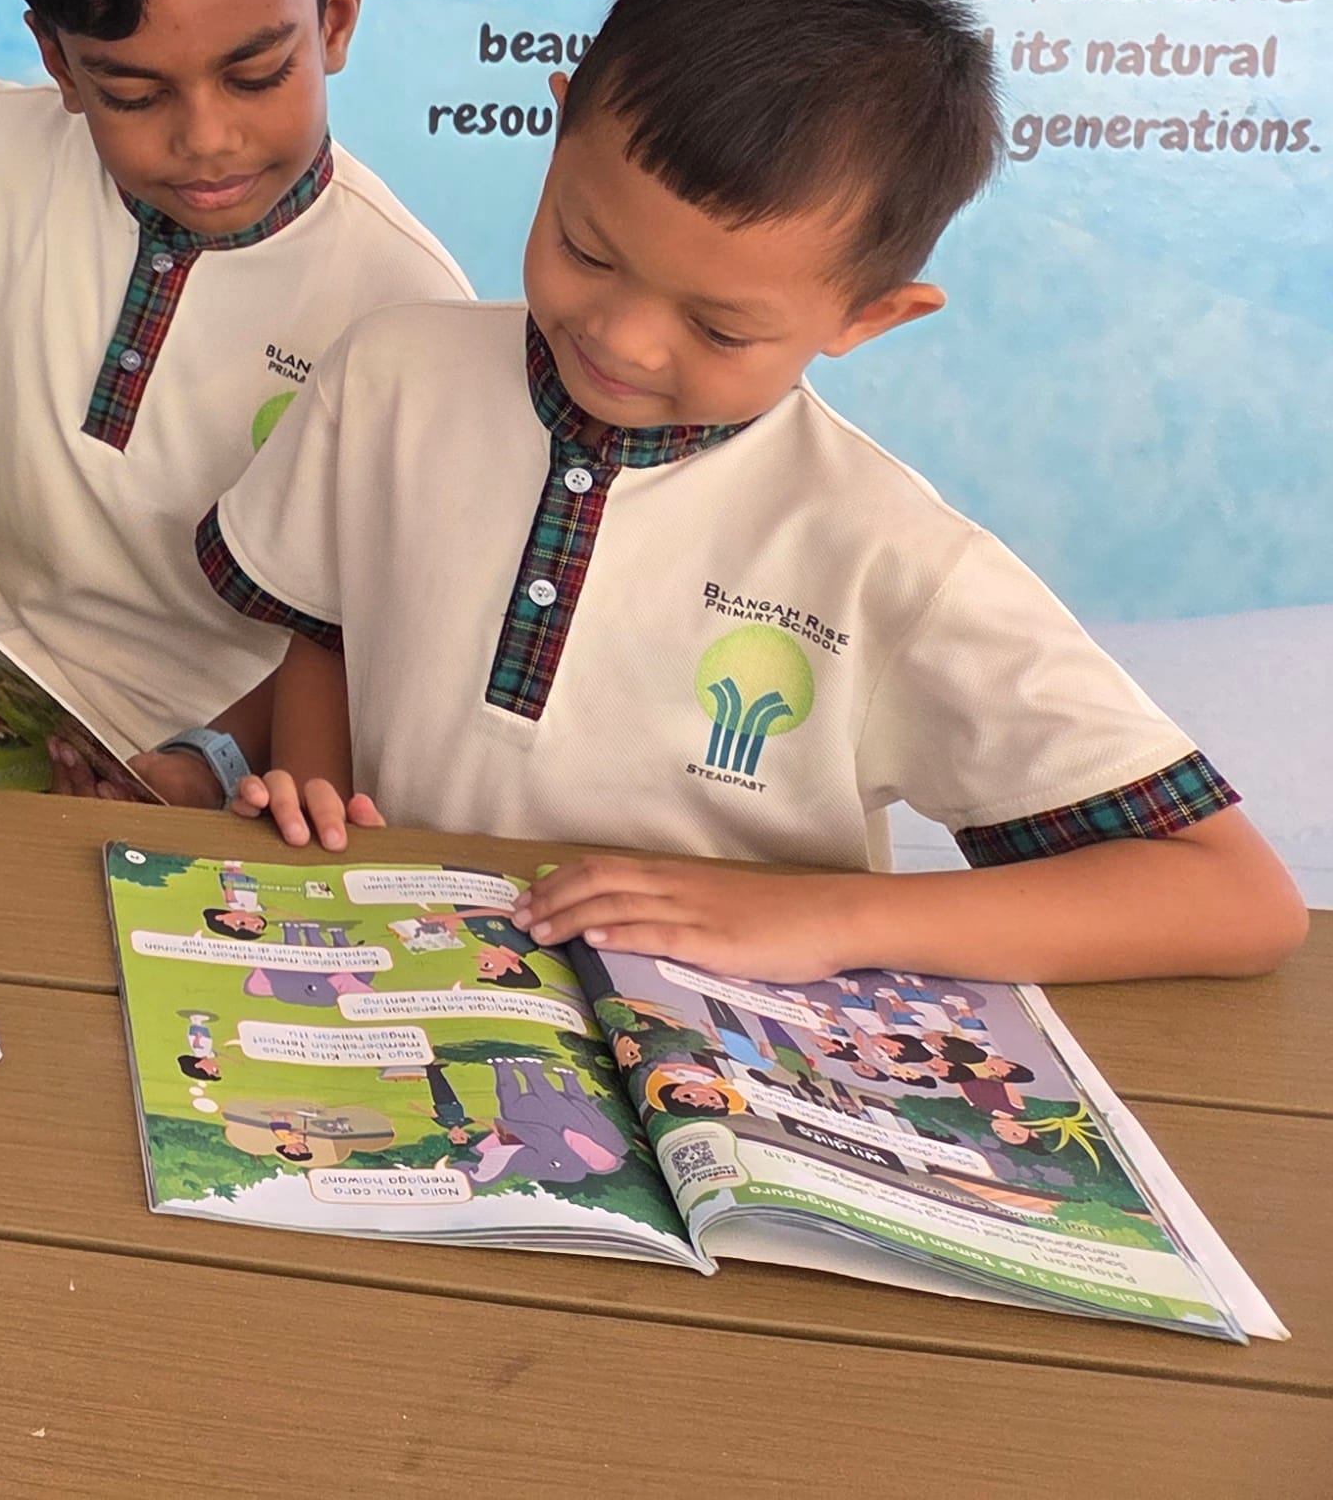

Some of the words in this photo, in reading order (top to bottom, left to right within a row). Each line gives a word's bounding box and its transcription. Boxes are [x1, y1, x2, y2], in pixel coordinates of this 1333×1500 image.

[479, 21, 596, 66] beau
[1010, 31, 1070, 75] its
[1083, 31, 1278, 78] natural
[428, 101, 554, 138] resou
[1007, 107, 1320, 161] generations.
[703, 581, 800, 621] BLANGAH
[805, 614, 851, 646] RISE
[704, 598, 775, 624] PRIMARY
[778, 616, 841, 656] SCHOOL
[685, 763, 767, 793] STEADFAST
[445, 995, 496, 1006] haiwan
[383, 1005, 465, 1015] kebersihan
[468, 1001, 529, 1017] Menjaga
[252, 1034, 306, 1048] tempat
[314, 1031, 364, 1042] haiwan
[310, 1040, 421, 1051] membersihkan
[261, 1046, 307, 1060] harus
[311, 1050, 340, 1061] Kita
[388, 1048, 425, 1061] Saya
[320, 1175, 383, 1186] haiwan?
[388, 1174, 455, 1185] menjaga
[333, 1187, 371, 1197] cara
[377, 1187, 414, 1197] tahu
[420, 1187, 459, 1197] Naila
[748, 1184, 850, 1217] Singapura
[852, 1212, 924, 1248] Haiwan
[928, 1236, 996, 1268] Taman
[999, 1260, 1026, 1277] Ke
[1053, 1276, 1153, 1309] Bahagian
